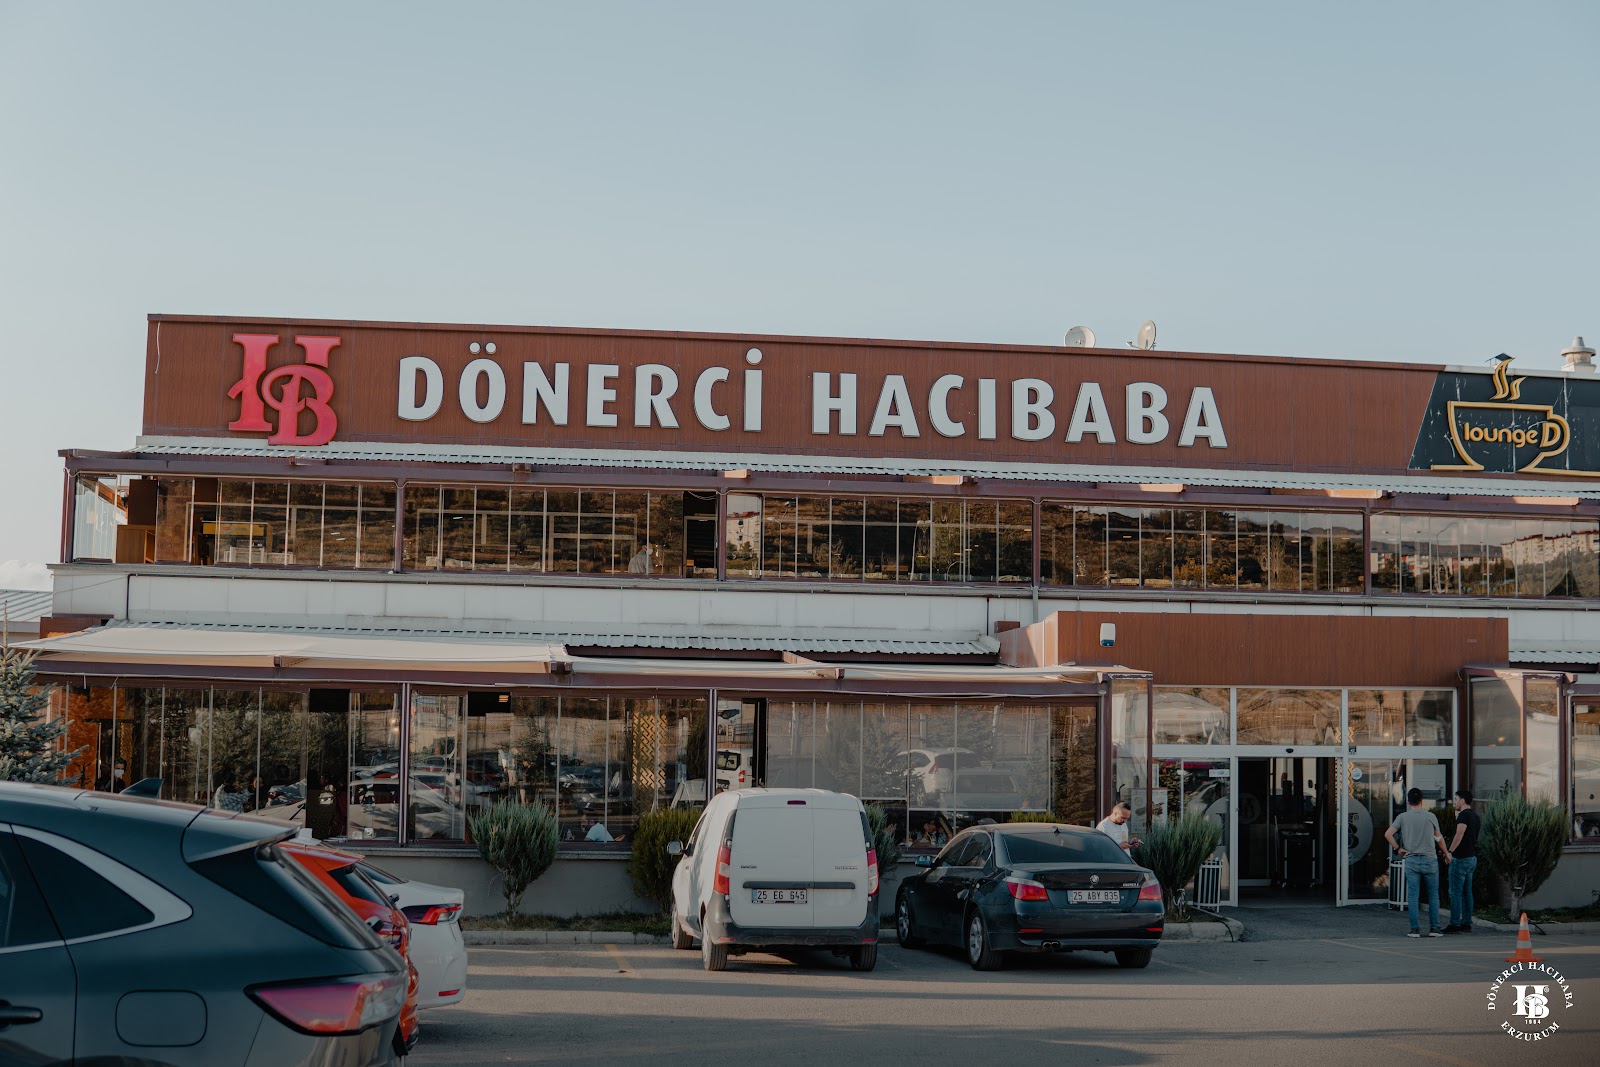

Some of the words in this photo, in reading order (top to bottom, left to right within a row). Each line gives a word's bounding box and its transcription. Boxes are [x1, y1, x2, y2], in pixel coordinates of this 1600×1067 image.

[397, 342, 764, 433] DÖNERCİ
[812, 372, 1229, 449] HACIBABA
[1463, 422, 1538, 449] lounge
[757, 891, 768, 900] 25
[773, 891, 784, 900] EG
[789, 891, 806, 900] 645
[1073, 891, 1083, 900] 25
[1087, 891, 1101, 900] ABY
[1104, 891, 1119, 900] 835
